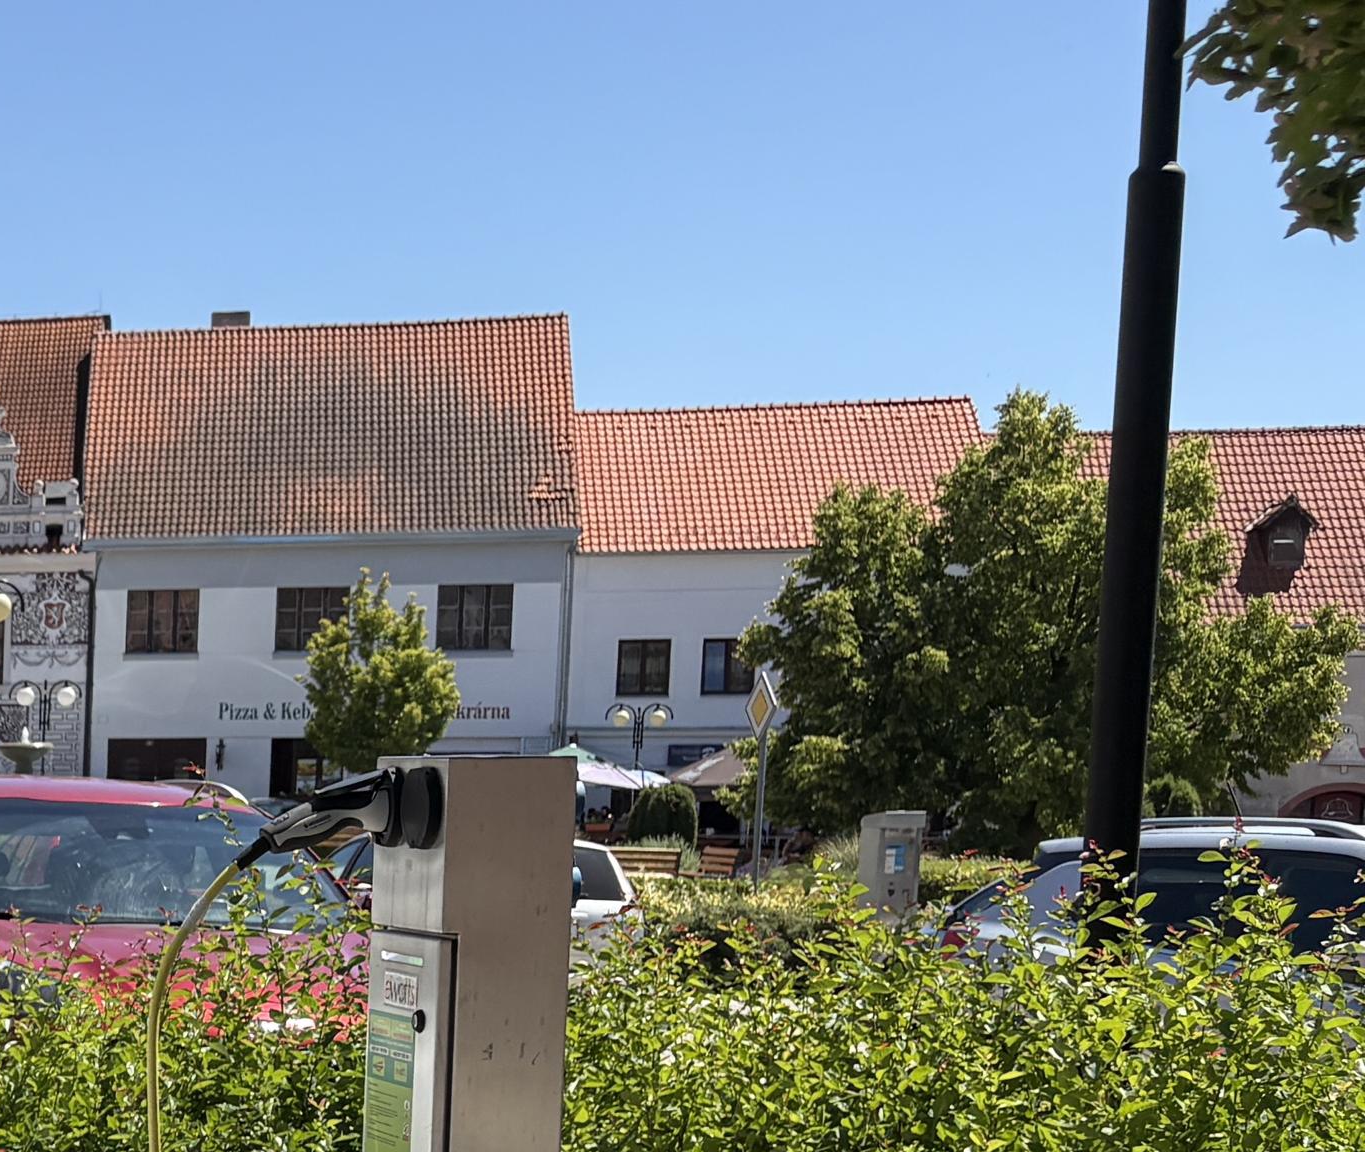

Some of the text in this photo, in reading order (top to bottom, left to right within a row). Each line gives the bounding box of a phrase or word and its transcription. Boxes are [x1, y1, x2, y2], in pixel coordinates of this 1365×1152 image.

[219, 701, 511, 720] Pizza & Keb krárna
